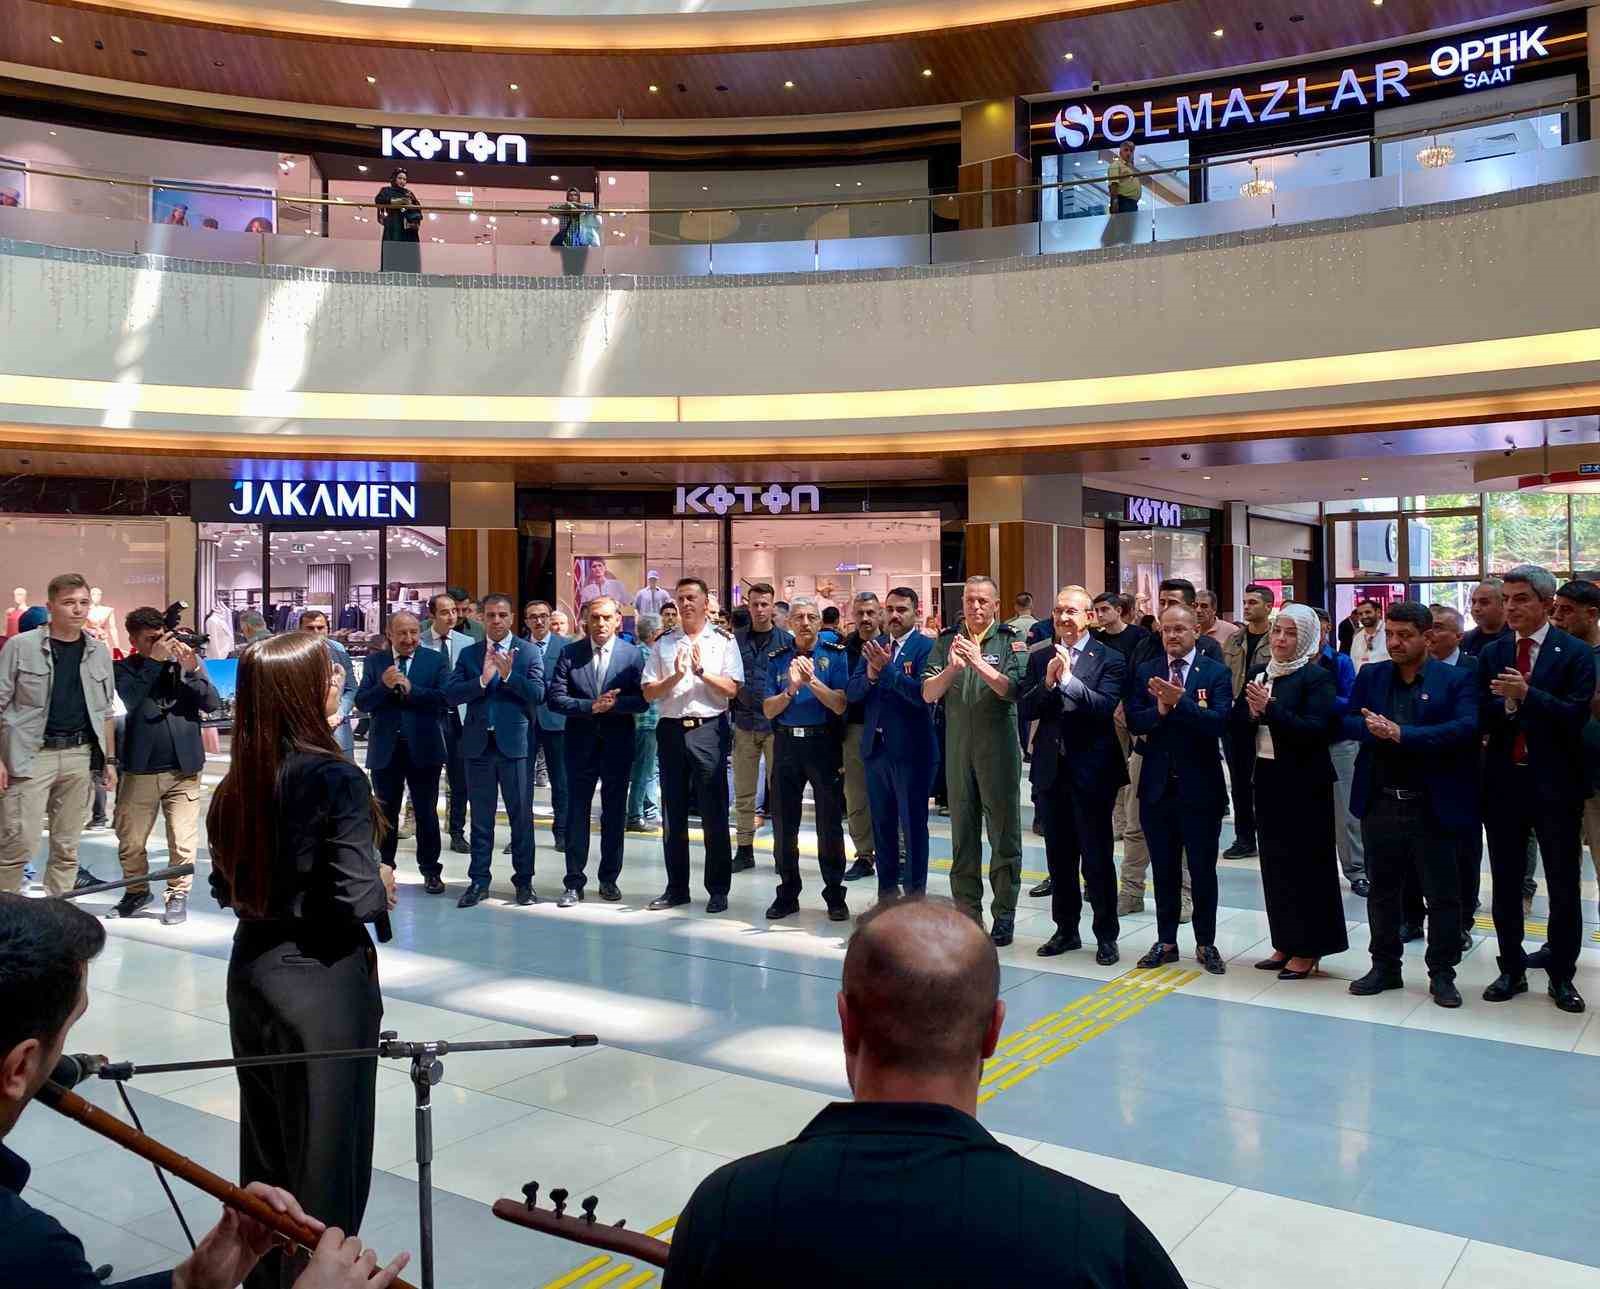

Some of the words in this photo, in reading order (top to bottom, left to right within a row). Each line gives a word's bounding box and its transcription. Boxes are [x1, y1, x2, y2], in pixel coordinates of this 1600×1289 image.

[1463, 65, 1515, 89] SAAT
[382, 127, 527, 162] KOTON
[229, 481, 416, 518] JAKAMEN
[676, 484, 820, 515] KOTON
